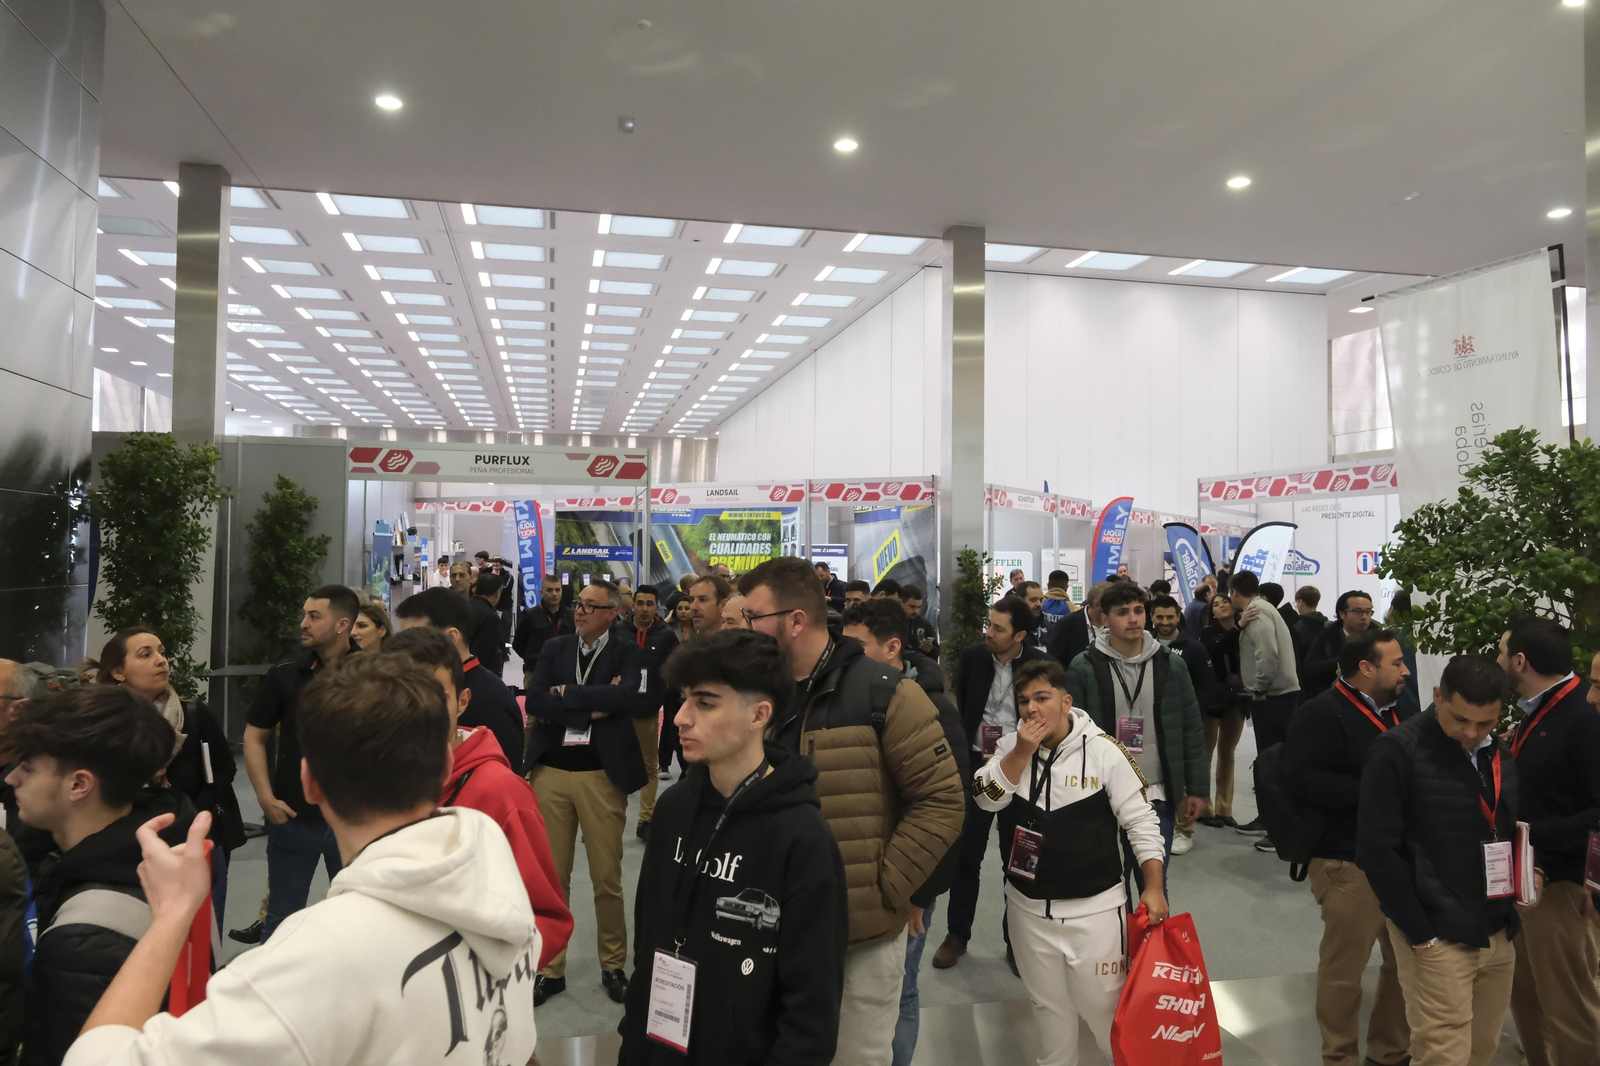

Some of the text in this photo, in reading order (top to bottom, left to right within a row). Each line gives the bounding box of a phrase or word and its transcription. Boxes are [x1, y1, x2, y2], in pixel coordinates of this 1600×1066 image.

[475, 455, 530, 465] PURFLUX
[709, 531, 771, 541] EL NEUMÁTICO CON
[709, 543, 771, 554] CUALIDADES
[1065, 775, 1099, 789] ICON
[1095, 959, 1125, 975] ICON
[655, 977, 685, 991] ACREDITACIÓN
